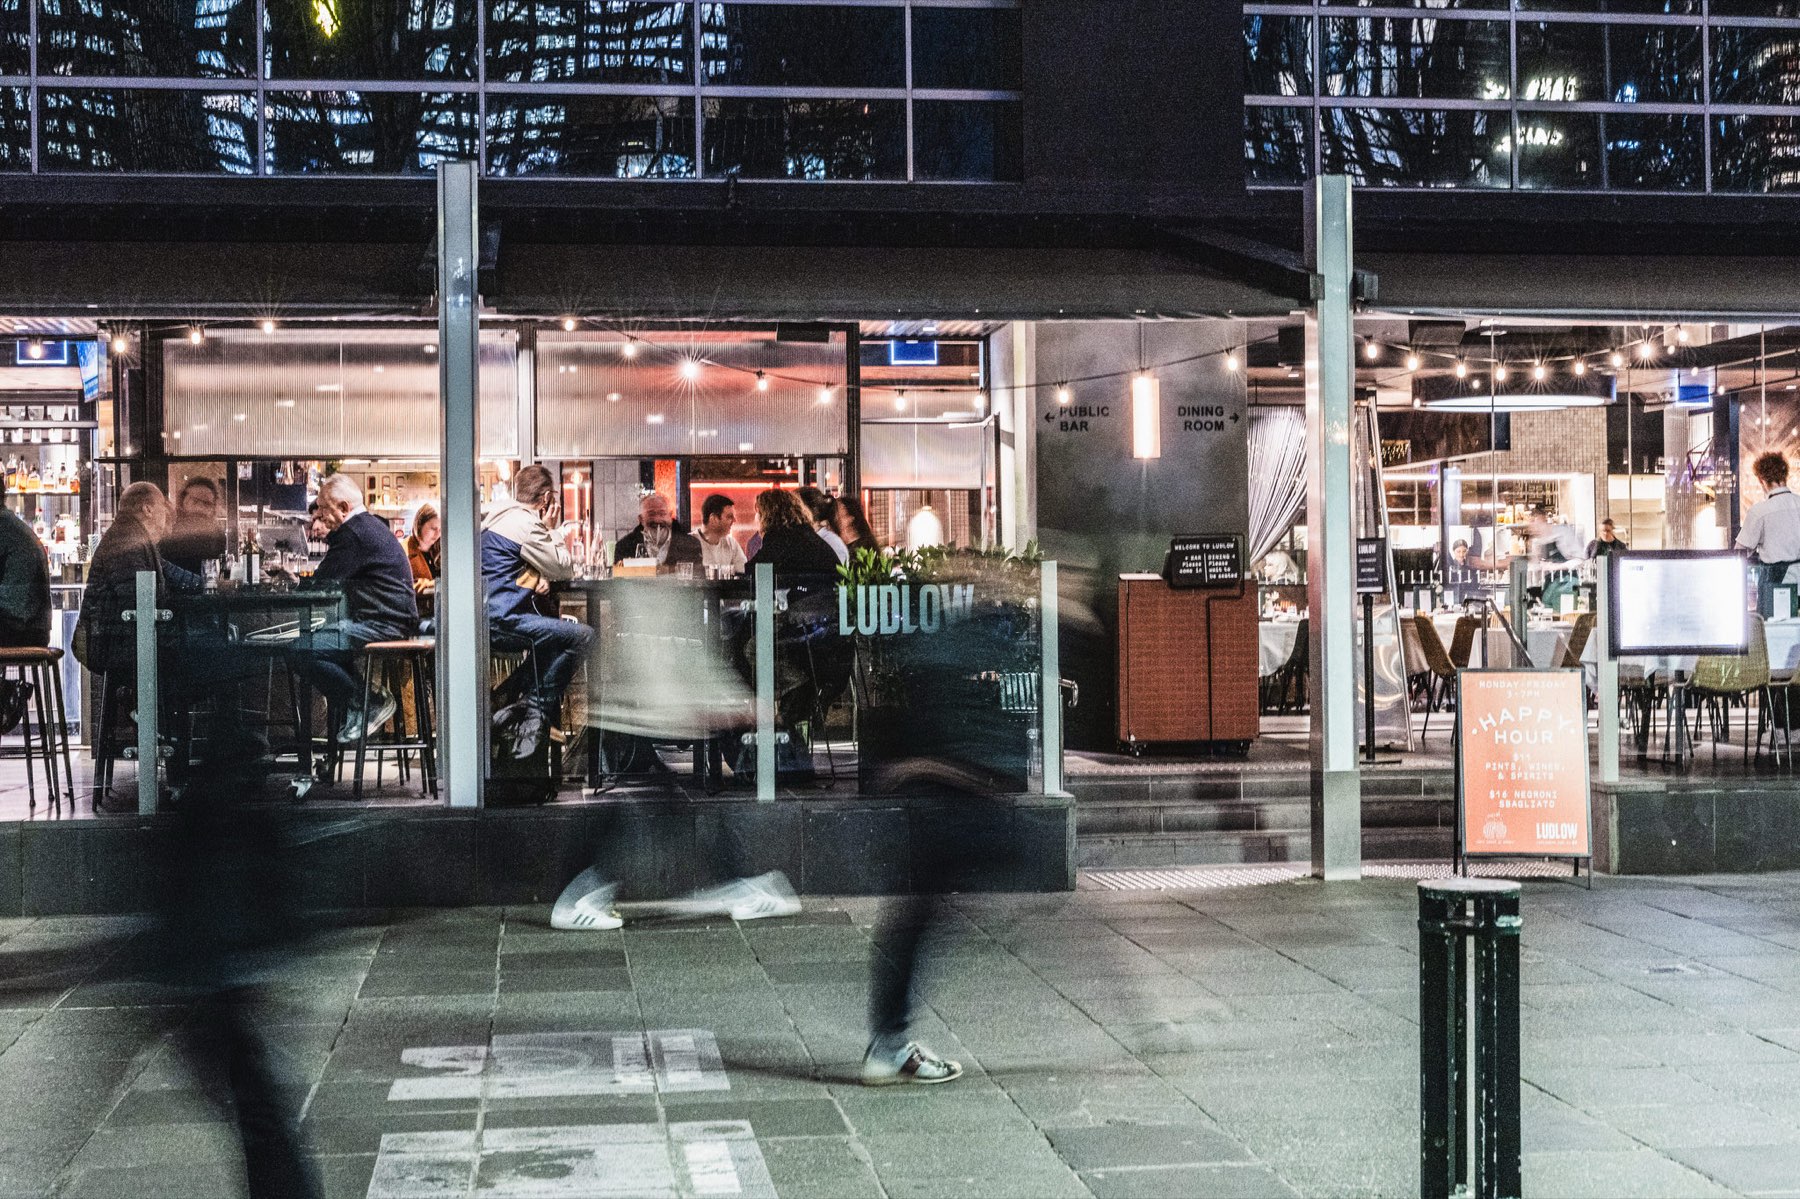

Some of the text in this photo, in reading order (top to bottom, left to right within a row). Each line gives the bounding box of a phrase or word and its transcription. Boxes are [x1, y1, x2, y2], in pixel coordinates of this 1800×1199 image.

[1060, 406, 1109, 417] PUBLIC
[1178, 406, 1224, 417] DINING
[1060, 421, 1088, 432] BAR
[1184, 420, 1225, 431] ROOM
[1174, 543, 1200, 551] WELCOME
[1212, 542, 1235, 550] LUDLOW
[838, 584, 975, 636] LUDLOW
[1478, 706, 1573, 732] HAPPY
[1494, 729, 1553, 744] HOUR
[1485, 762, 1521, 771] PINTS,
[1497, 772, 1554, 780] & SPIRITS
[1514, 790, 1558, 799] NEGRONI
[1498, 800, 1555, 808] SBAGLIATO
[1536, 823, 1578, 839] LUDLOW
